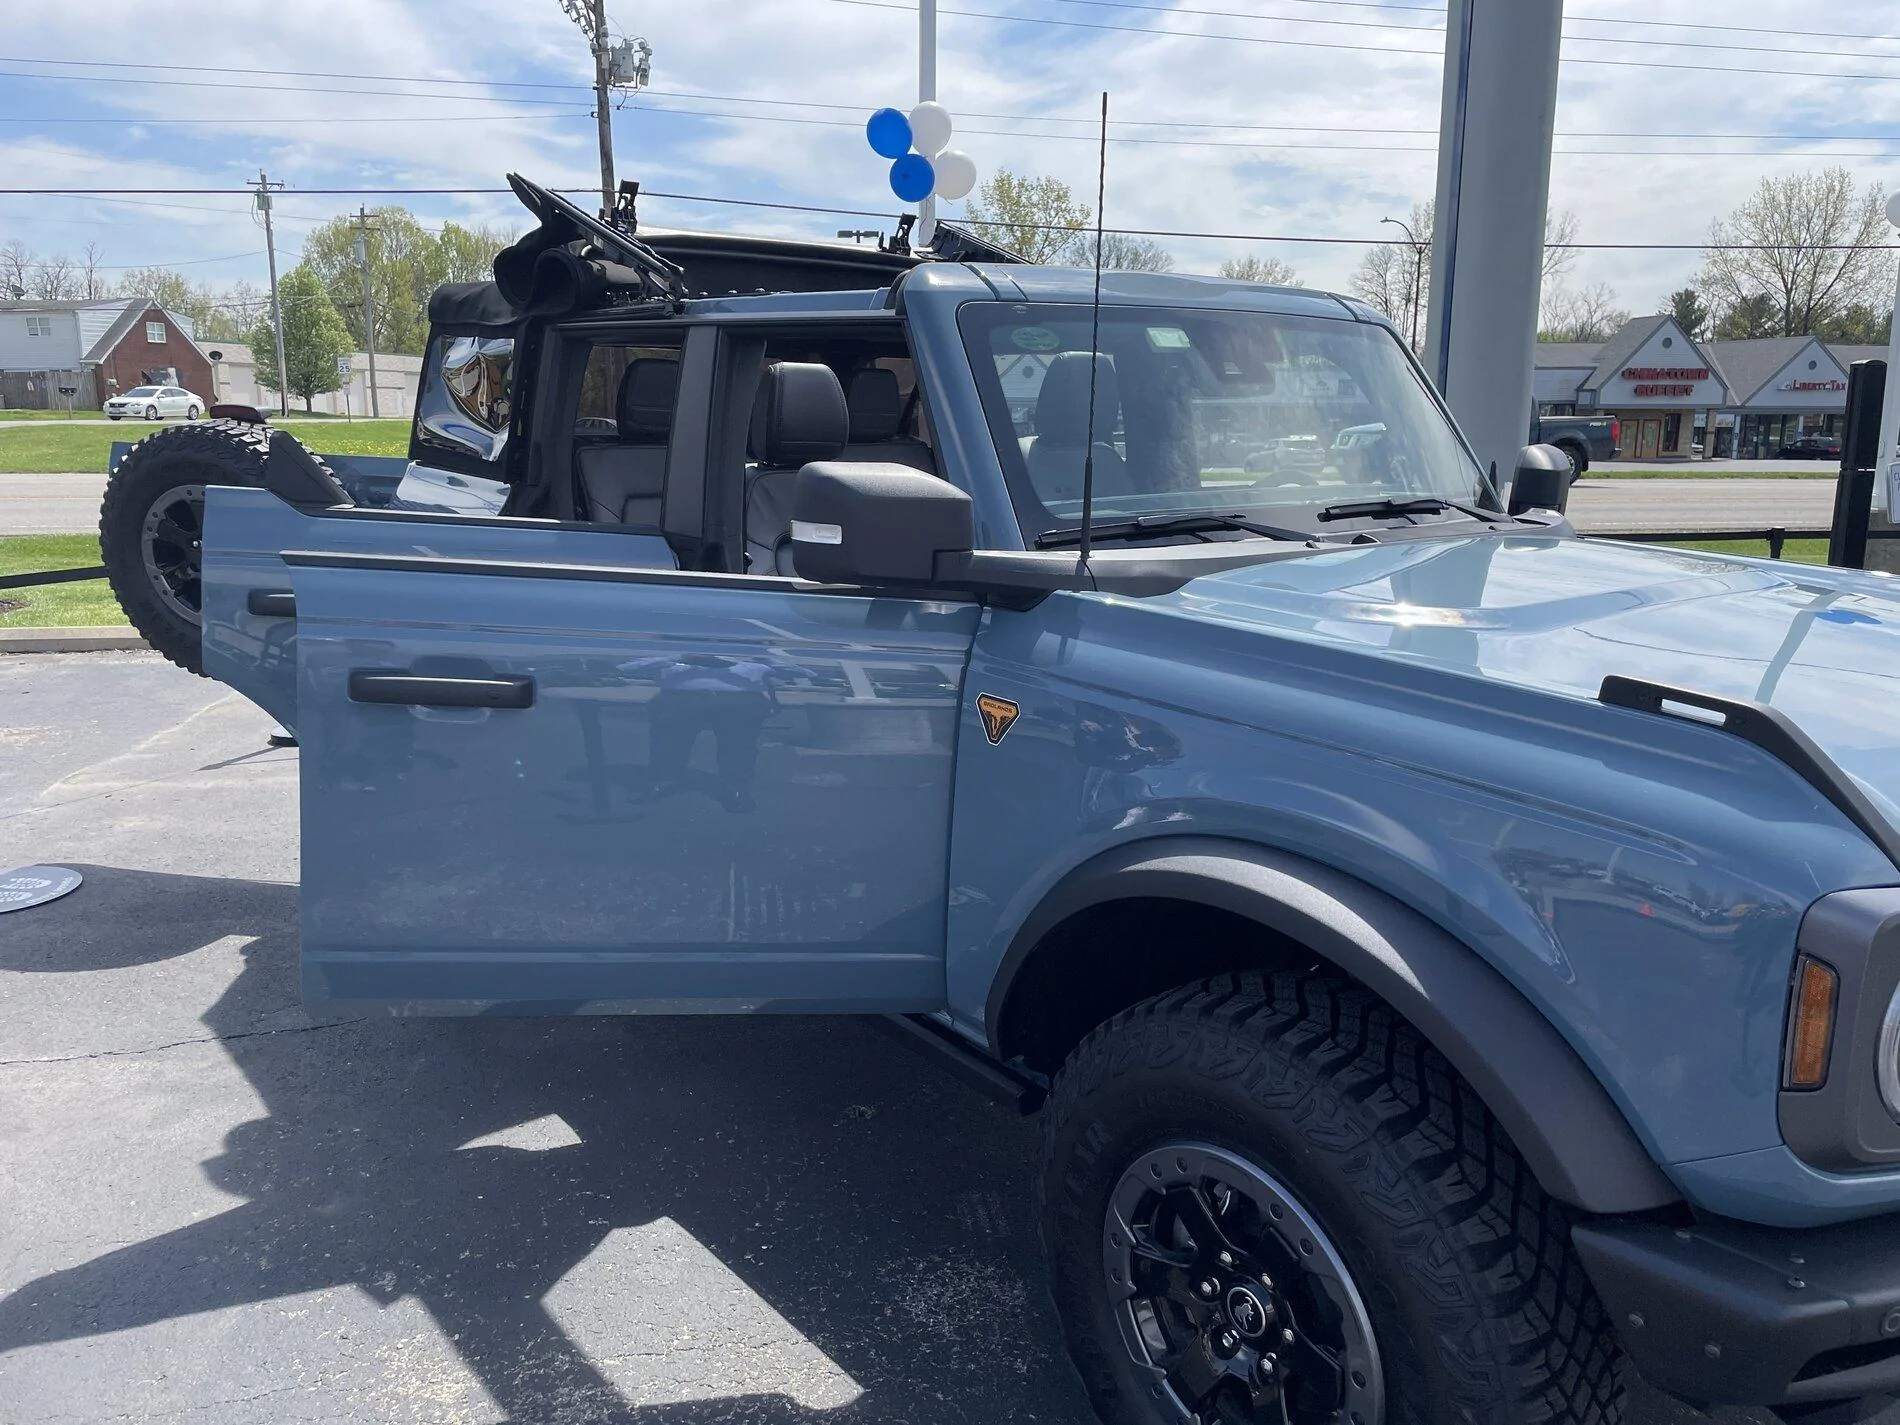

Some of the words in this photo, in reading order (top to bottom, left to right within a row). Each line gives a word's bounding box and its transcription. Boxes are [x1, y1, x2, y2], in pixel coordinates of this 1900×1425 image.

[1622, 367, 1709, 380] CHINATOWN
[1634, 384, 1694, 397] BUFFET
[1793, 379, 1827, 391] LIBERTY
[1830, 379, 1846, 391] TAX
